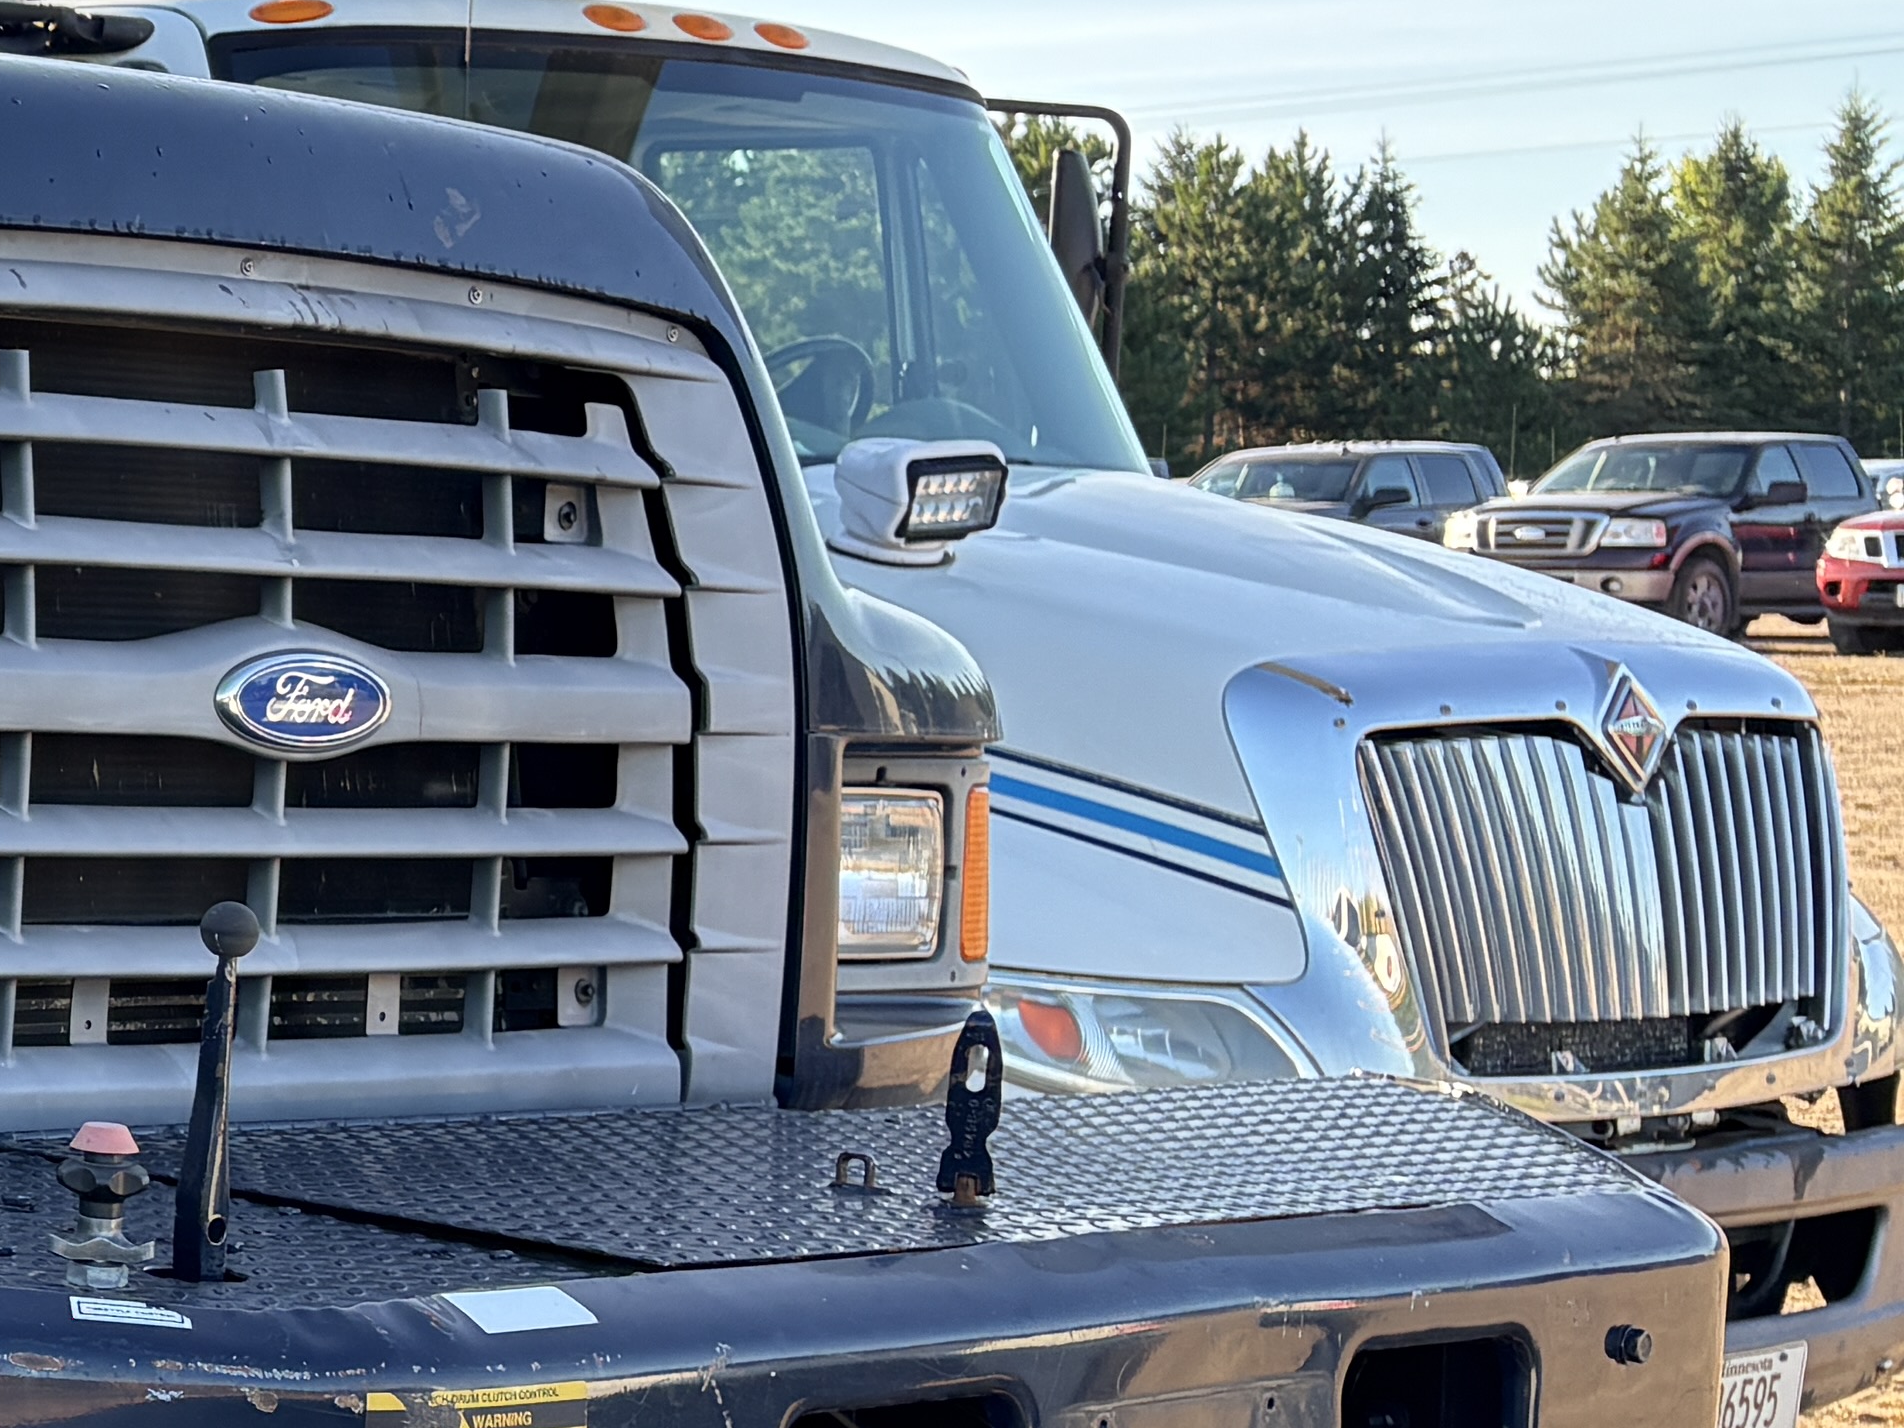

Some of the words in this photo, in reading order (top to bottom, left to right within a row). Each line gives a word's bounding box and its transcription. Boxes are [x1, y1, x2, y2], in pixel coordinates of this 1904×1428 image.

[266, 671, 355, 724] Ford
[481, 1389, 517, 1404] CLUTCH
[518, 1387, 559, 1400] CONTROL
